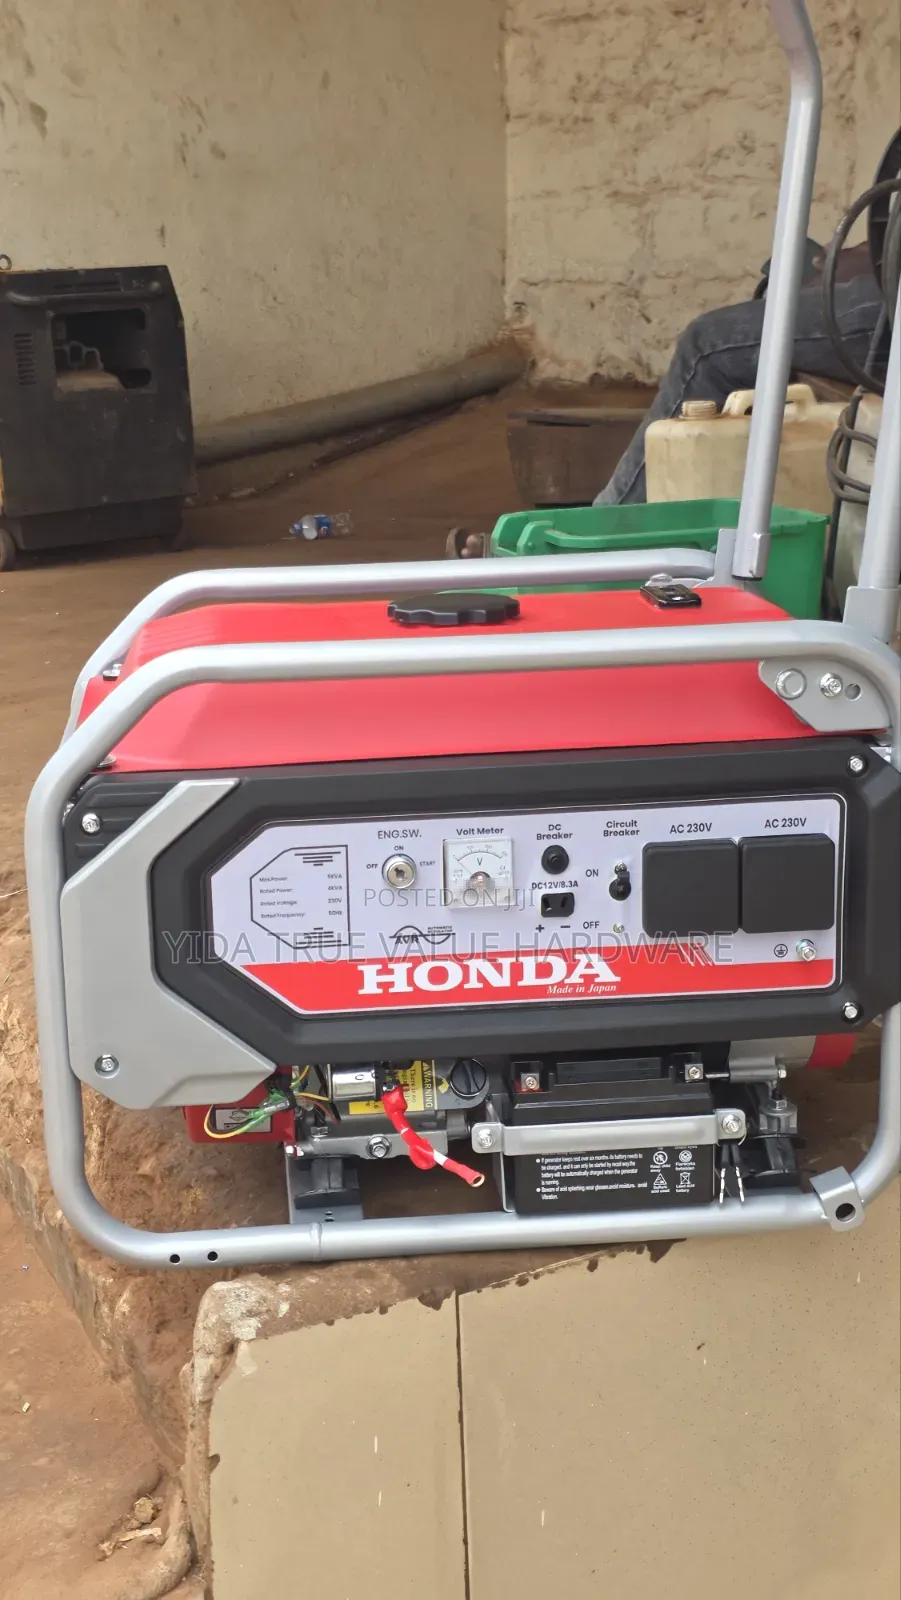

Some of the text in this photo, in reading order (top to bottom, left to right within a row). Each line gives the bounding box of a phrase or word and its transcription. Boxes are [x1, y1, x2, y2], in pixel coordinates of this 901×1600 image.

[606, 820, 638, 828] Circuit
[764, 817, 806, 828] AC 230V
[476, 827, 504, 835] Meter
[603, 828, 640, 837] Breaker
[670, 822, 712, 834] AC 230V
[377, 828, 422, 839] ENG.SW.
[536, 832, 573, 840] Breaker
[476, 858, 483, 866] V
[585, 868, 598, 878] ON
[531, 880, 579, 890] DC12V/8.3A
[582, 921, 600, 929] OFF
[358, 953, 621, 994] HONDA
[547, 984, 617, 994] Made in Japan
[424, 1070, 433, 1108] WARNING
